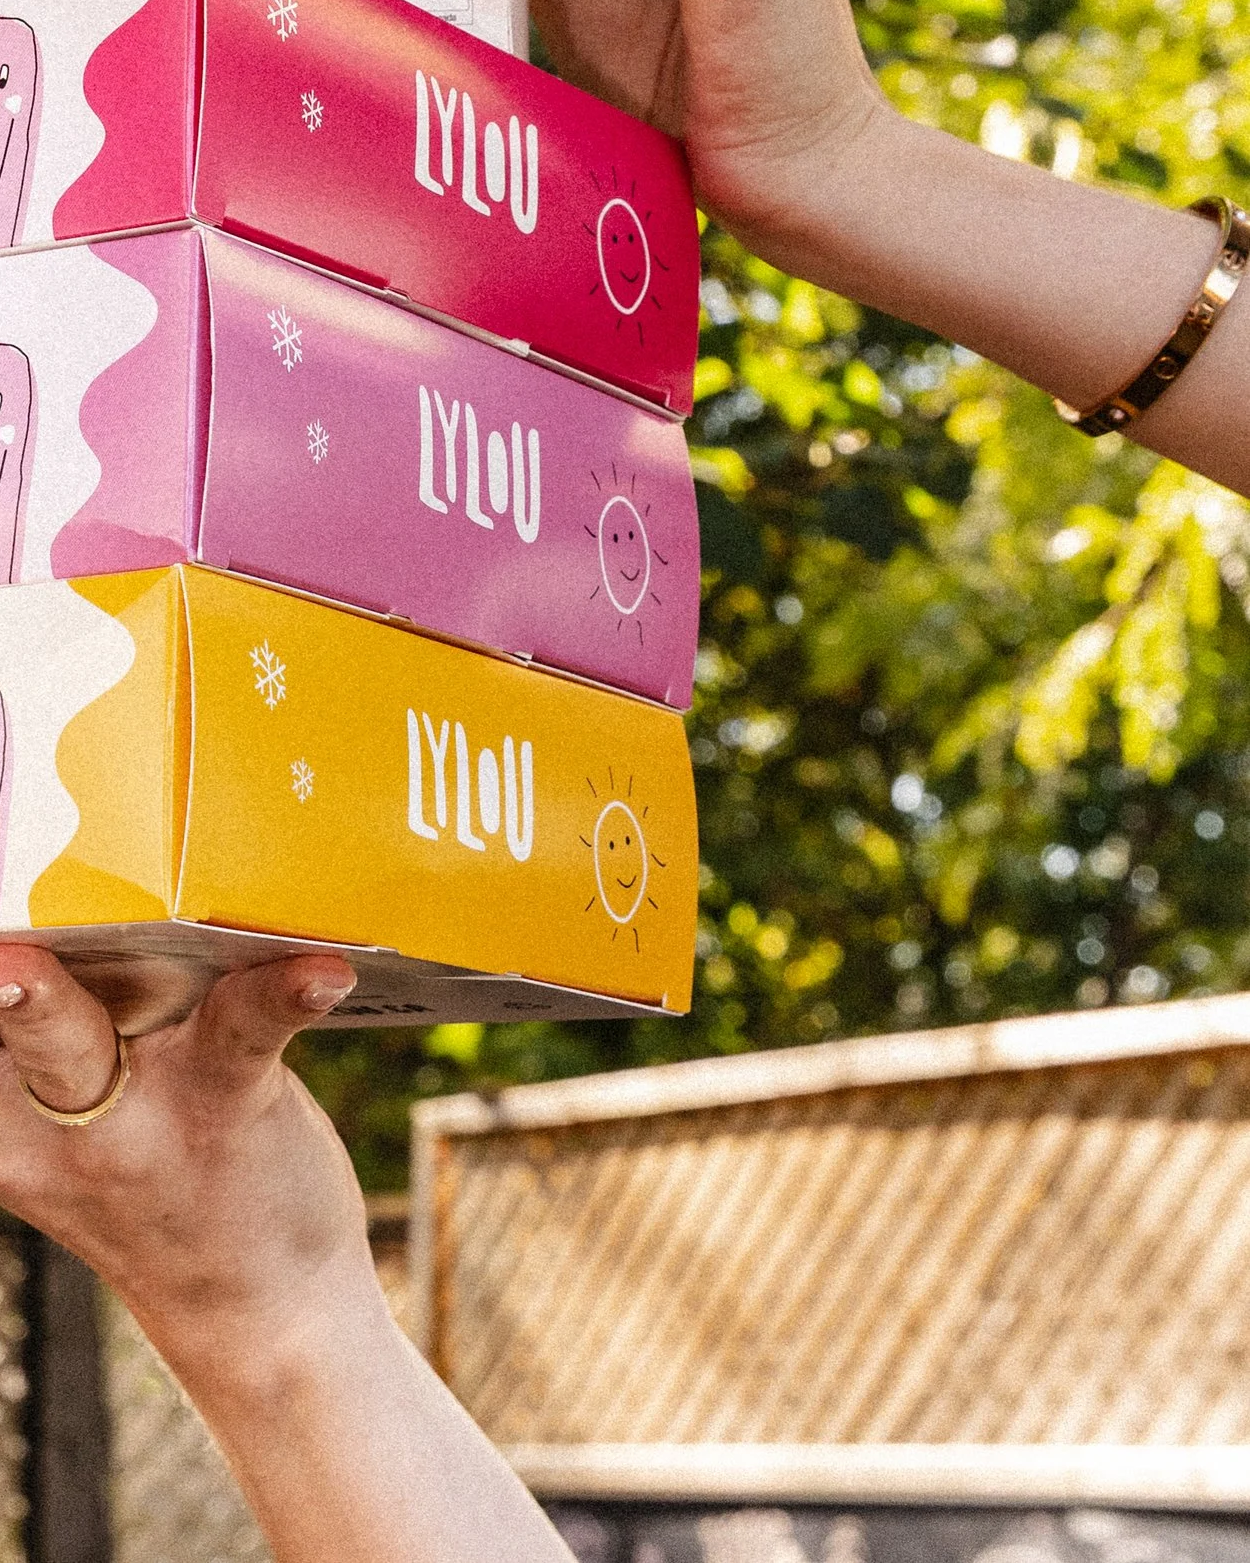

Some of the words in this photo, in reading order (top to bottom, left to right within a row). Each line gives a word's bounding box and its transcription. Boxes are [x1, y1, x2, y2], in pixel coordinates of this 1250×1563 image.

[415, 69, 538, 234] LYLOU
[419, 385, 540, 543] LYLOU
[407, 709, 534, 861] LYLOU
